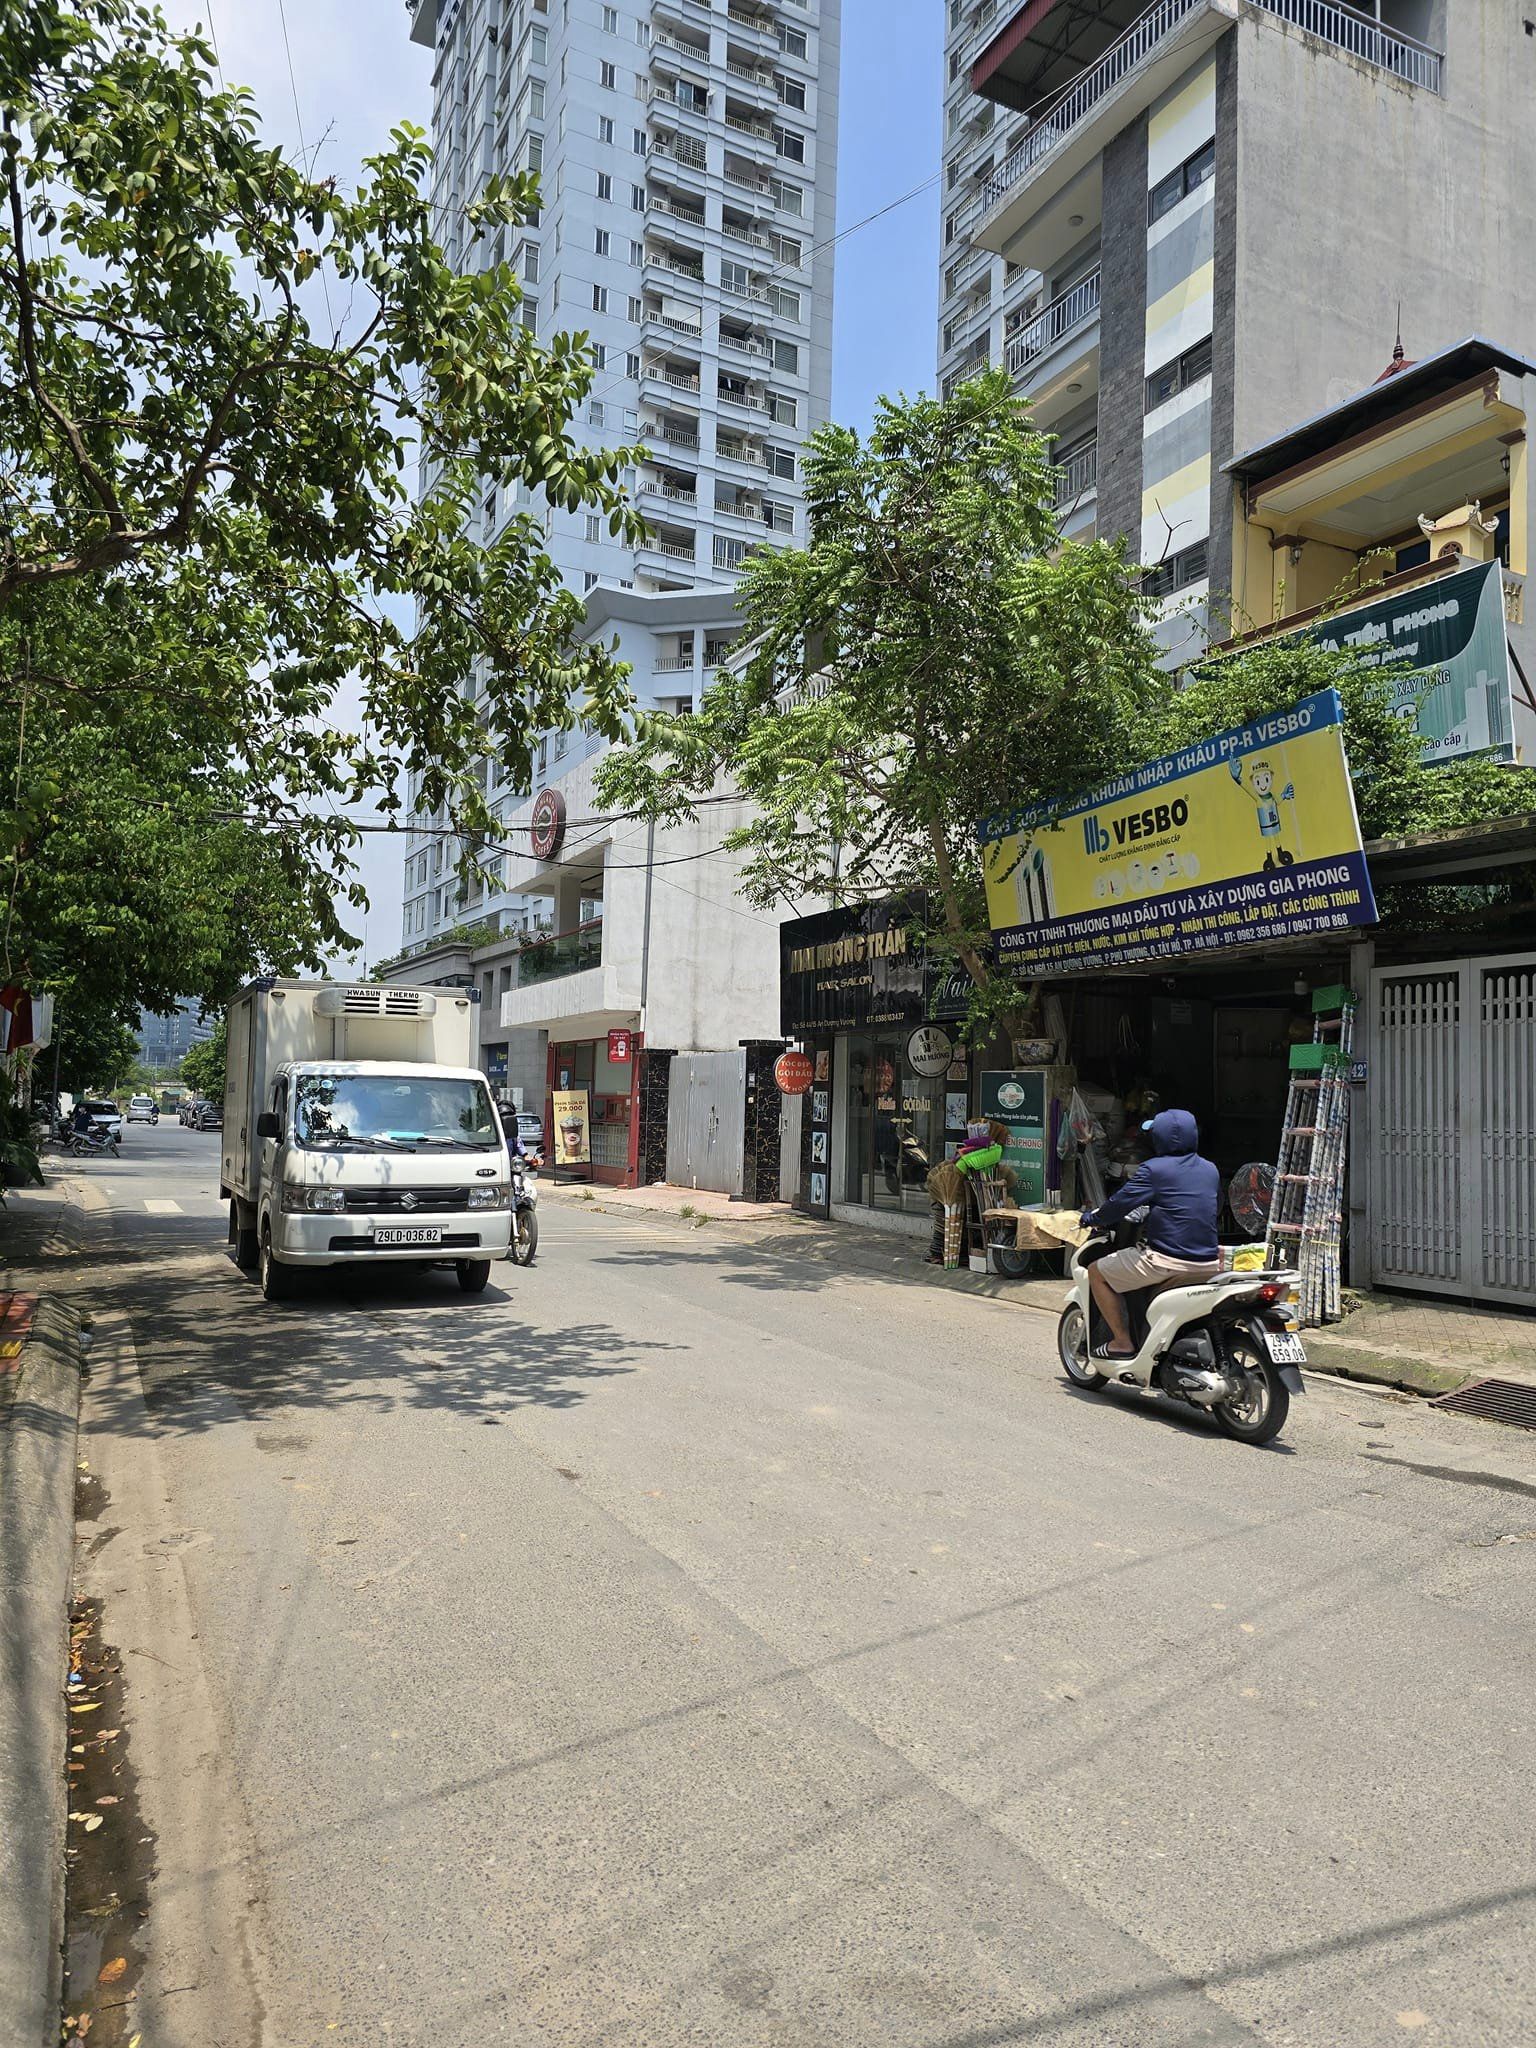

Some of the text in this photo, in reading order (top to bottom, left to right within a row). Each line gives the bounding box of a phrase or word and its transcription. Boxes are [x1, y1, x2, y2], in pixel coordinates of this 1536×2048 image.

[1392, 599, 1460, 634] PHONG
[1137, 760, 1174, 786] NHẬP
[1220, 730, 1254, 756] PP-R
[999, 865, 1350, 948] CÔNG TY TNHH THƯƠNG MẠI ĐẦU TƯ VÀ XÂY DỰNG GIA PHONG
[1051, 943, 1063, 958] VẬT
[1113, 932, 1127, 946] KIM
[1128, 930, 1140, 942] KHÍ
[1140, 924, 1160, 941] TỔNG
[1160, 923, 1176, 940] HỢP
[1181, 917, 1204, 934] NHẬN
[1204, 915, 1217, 930] THI
[1244, 904, 1260, 922] LẮP
[1262, 902, 1282, 920] ĐẶT,
[1282, 898, 1301, 916] CÁC
[1302, 894, 1329, 911] CÔNG
[1329, 888, 1361, 907] TRÌNH
[1183, 939, 1194, 950] TP.
[1194, 934, 1206, 948] HÀ
[1206, 933, 1219, 948] NỘI
[1237, 927, 1256, 941] 0962
[1256, 925, 1271, 938] 356
[1272, 922, 1287, 935] 686
[1293, 918, 1313, 932] 0947
[1314, 916, 1330, 929] 700
[1331, 913, 1349, 927] 868
[791, 947, 815, 974] MAI
[816, 936, 865, 969] HƯƠNG
[816, 975, 873, 991] HAIR SALON
[913, 1054, 927, 1062] MAI
[1017, 1137, 1042, 1150] PHONG
